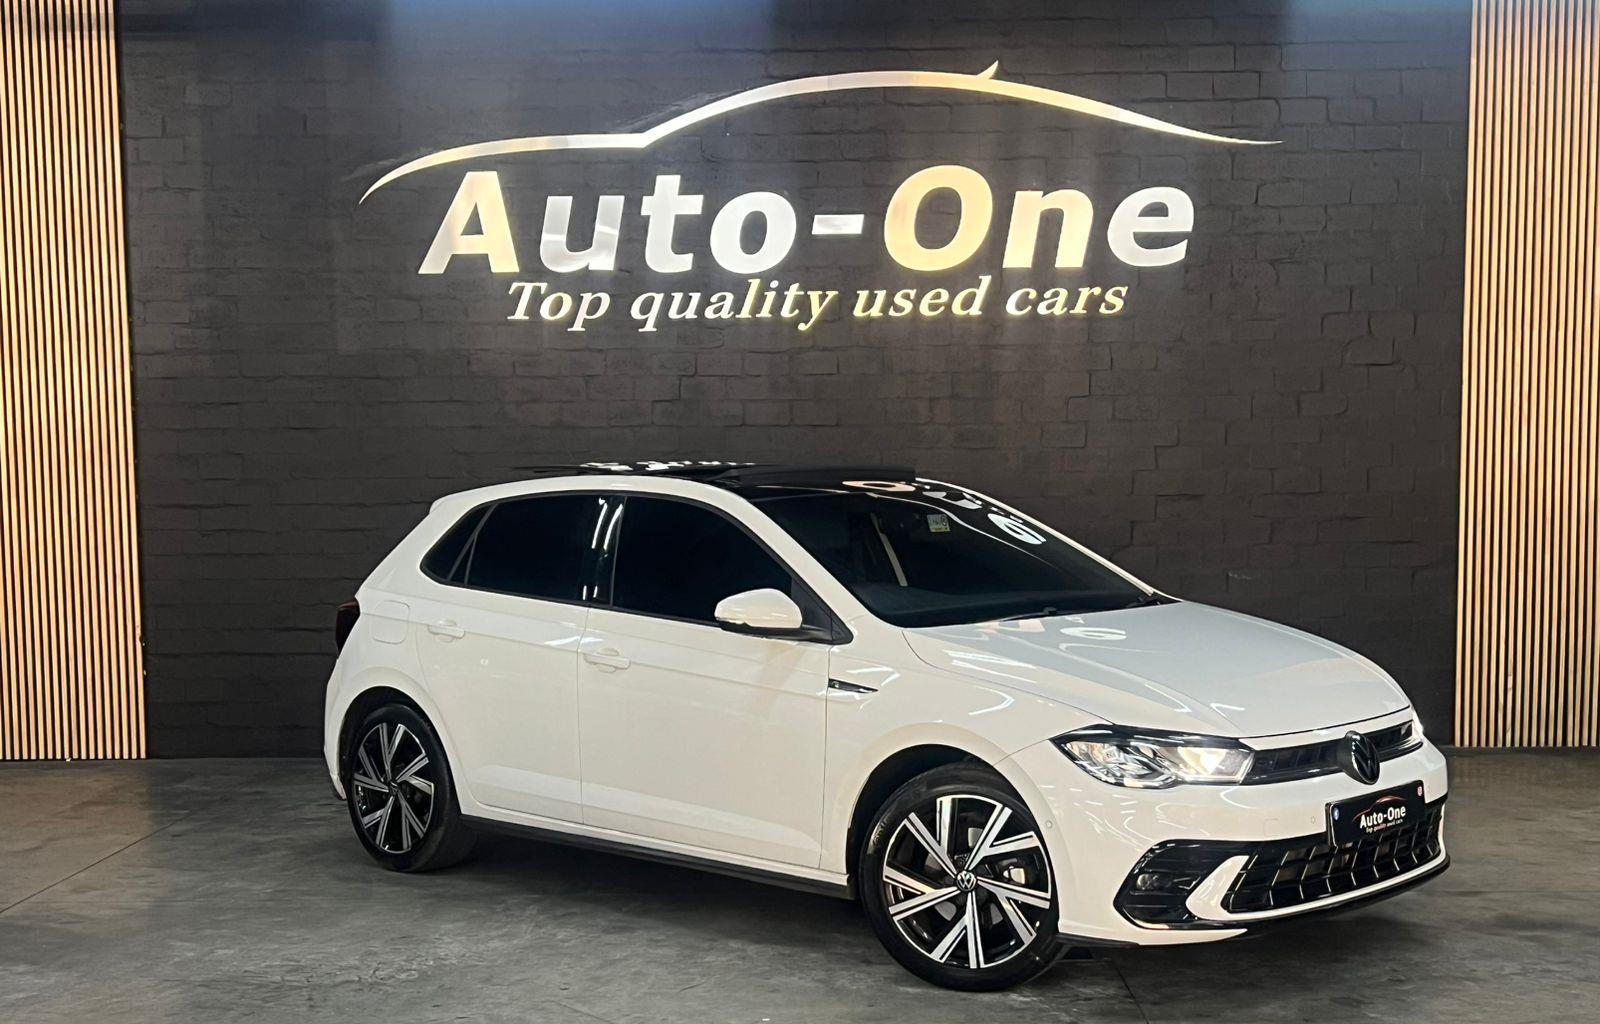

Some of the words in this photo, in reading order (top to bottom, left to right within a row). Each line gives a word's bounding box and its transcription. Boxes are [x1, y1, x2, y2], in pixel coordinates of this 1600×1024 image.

[418, 165, 1195, 275] Auto-One
[506, 280, 611, 333] Top
[630, 277, 839, 333] quality
[852, 274, 993, 319] used
[1005, 285, 1130, 317] cars
[1360, 806, 1406, 829] Auto-One
